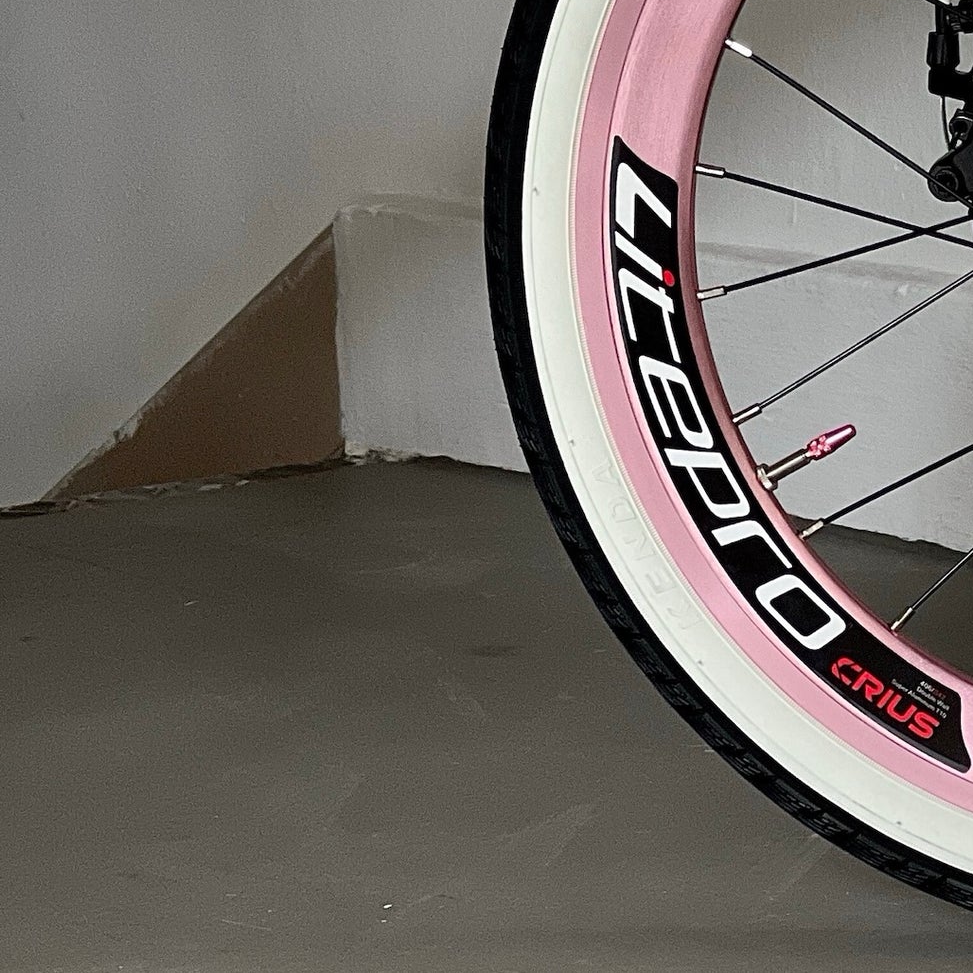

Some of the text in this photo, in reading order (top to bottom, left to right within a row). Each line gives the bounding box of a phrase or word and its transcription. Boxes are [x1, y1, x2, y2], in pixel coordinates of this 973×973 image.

[614, 162, 847, 652] Litepro
[587, 455, 704, 635] KENDA
[831, 657, 940, 739] CRIUS
